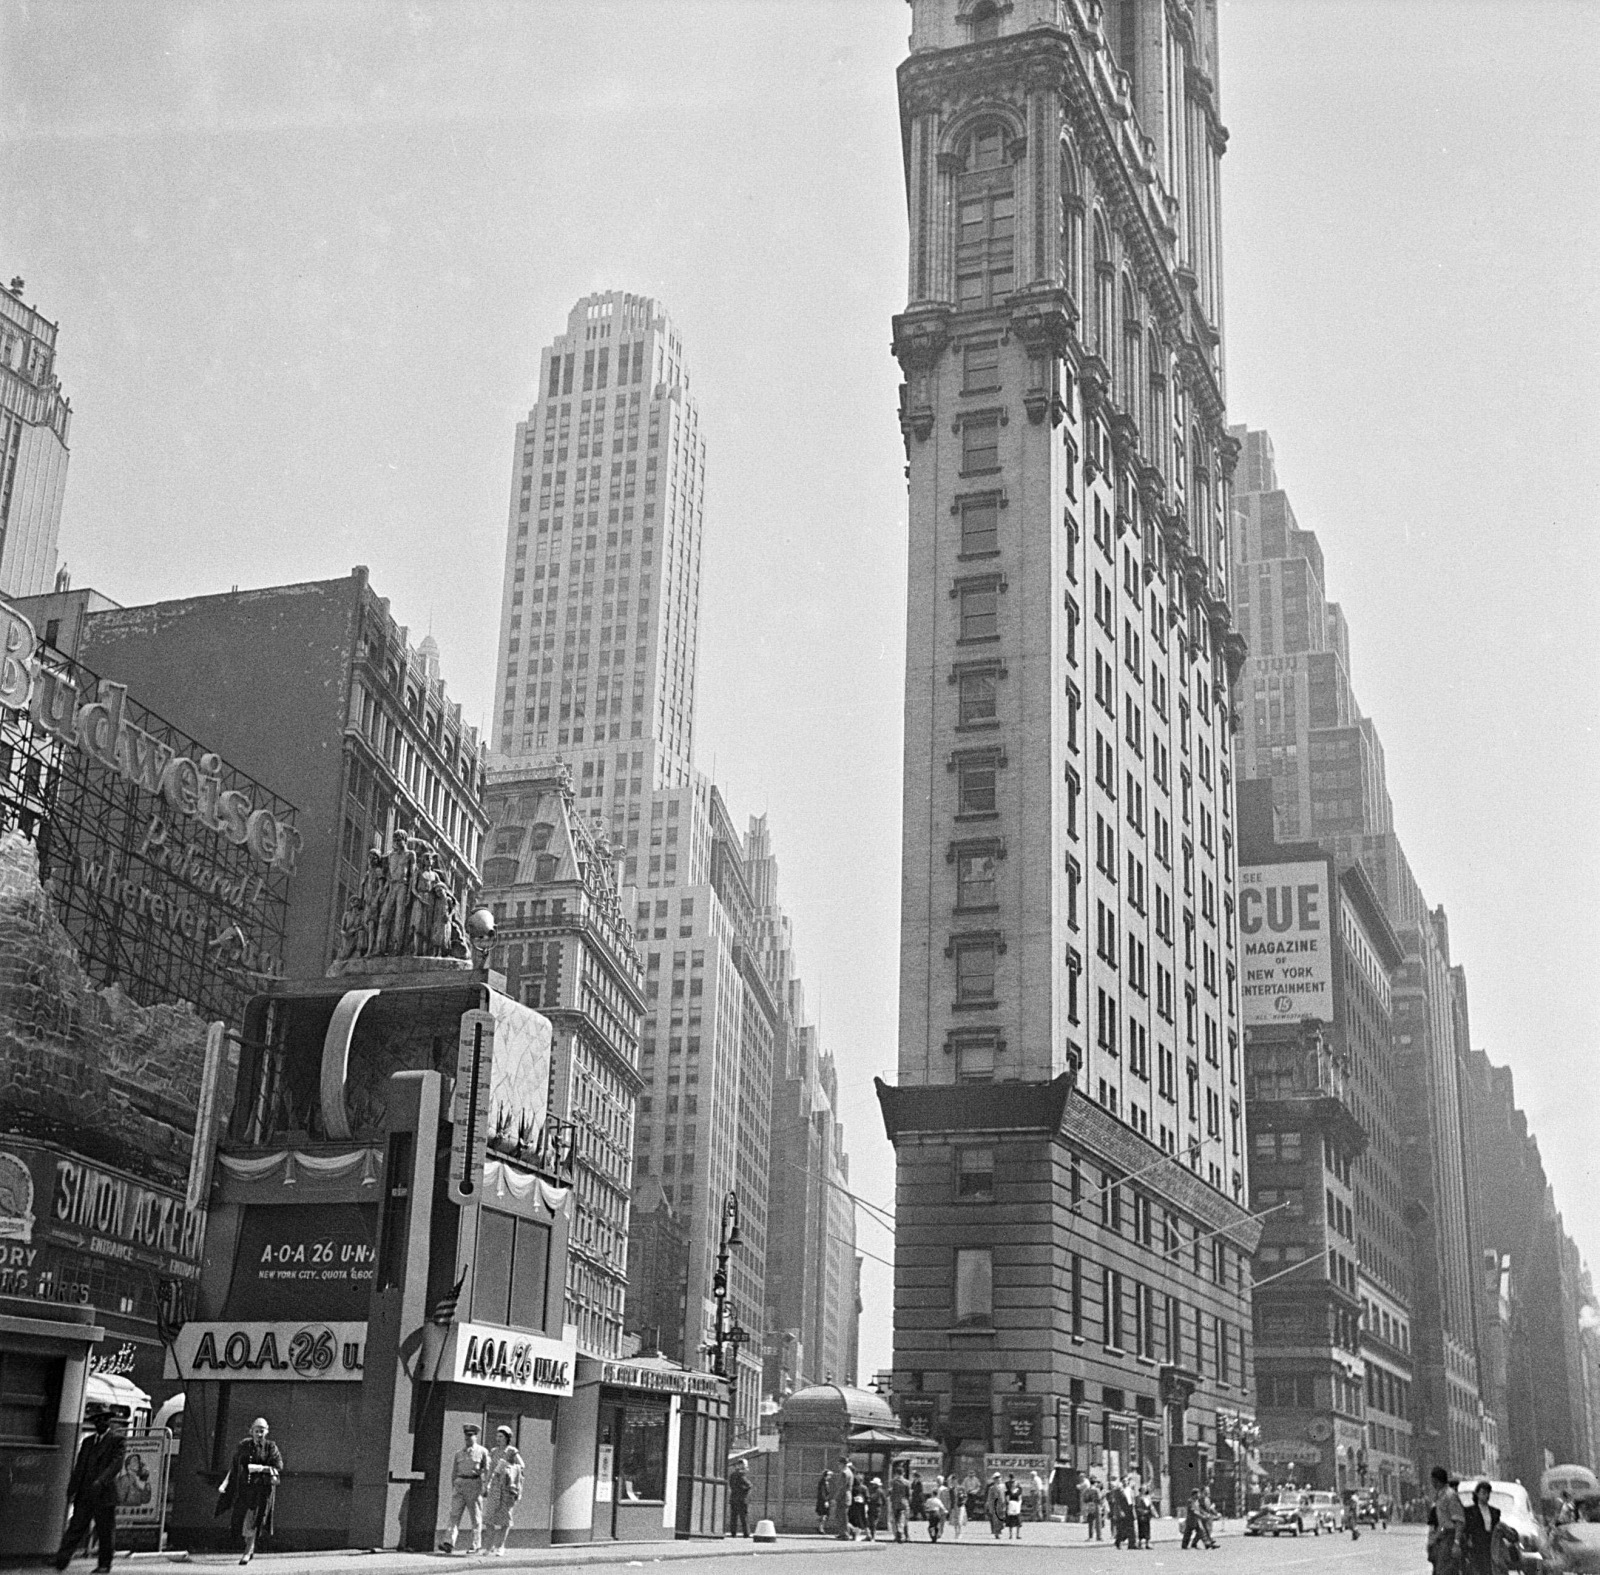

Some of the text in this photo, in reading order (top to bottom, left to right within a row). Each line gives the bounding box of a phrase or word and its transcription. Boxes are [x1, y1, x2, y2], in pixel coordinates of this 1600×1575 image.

[0, 600, 303, 876] Budweiser
[1243, 873, 1262, 883] SEE
[1239, 884, 1320, 934] CUE
[1246, 939, 1318, 955] MAGAZINE
[1247, 967, 1313, 980] NEW YORK
[57, 1160, 129, 1236] SIMON
[312, 1241, 334, 1262] 26
[259, 1270, 275, 1278] NEW
[276, 1270, 296, 1278] YORK
[321, 1270, 347, 1279] QUOTA
[293, 1330, 334, 1370] 26
[514, 1342, 532, 1379] 26
[987, 1459, 1045, 1467] NEWSPAPERS
